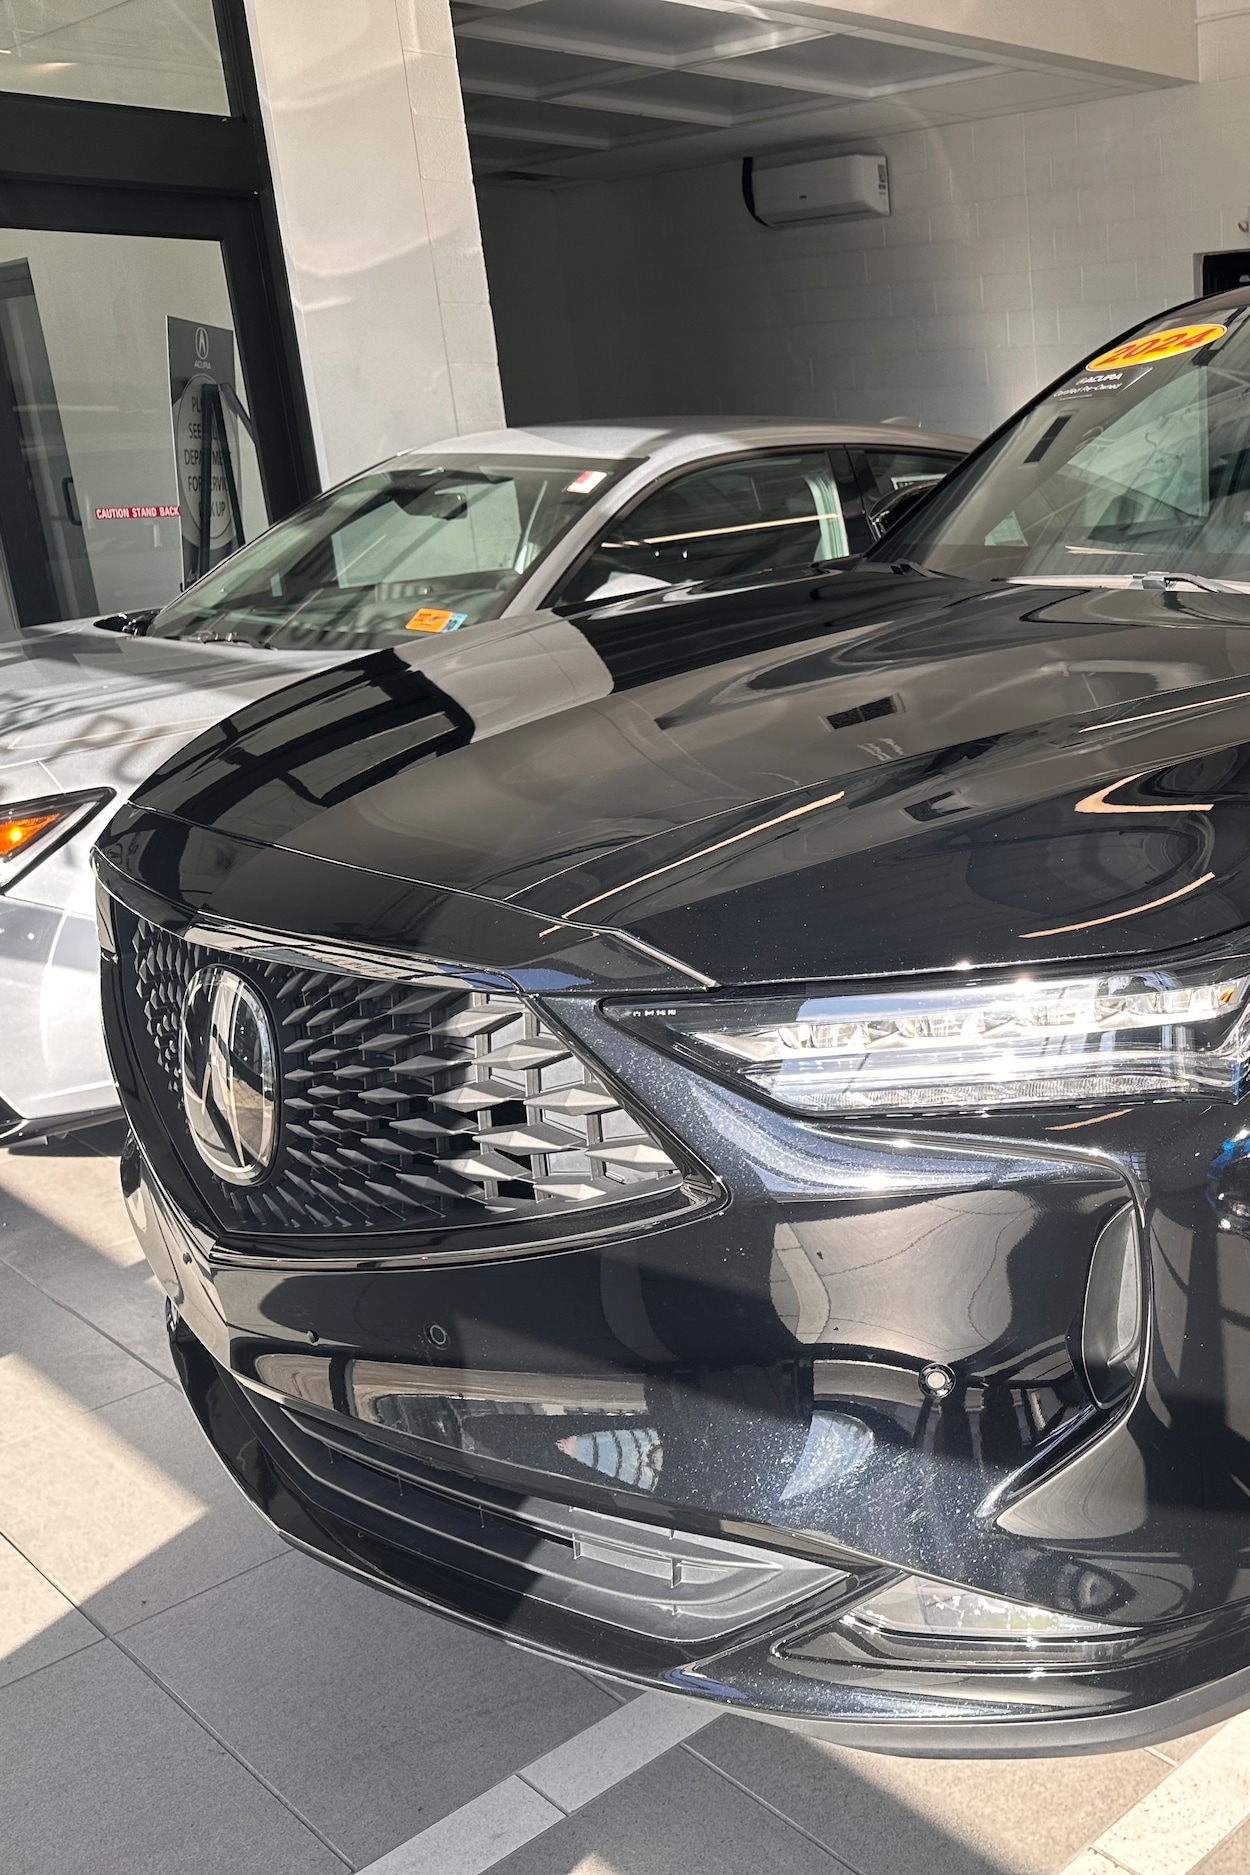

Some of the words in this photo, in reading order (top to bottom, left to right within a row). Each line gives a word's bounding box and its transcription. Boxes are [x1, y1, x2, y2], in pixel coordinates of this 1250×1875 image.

[1093, 328, 1218, 367] 2024
[193, 360, 212, 370] ACURA
[96, 508, 129, 519] CAUTION
[132, 506, 157, 517] STAND
[159, 505, 180, 516] BACK
